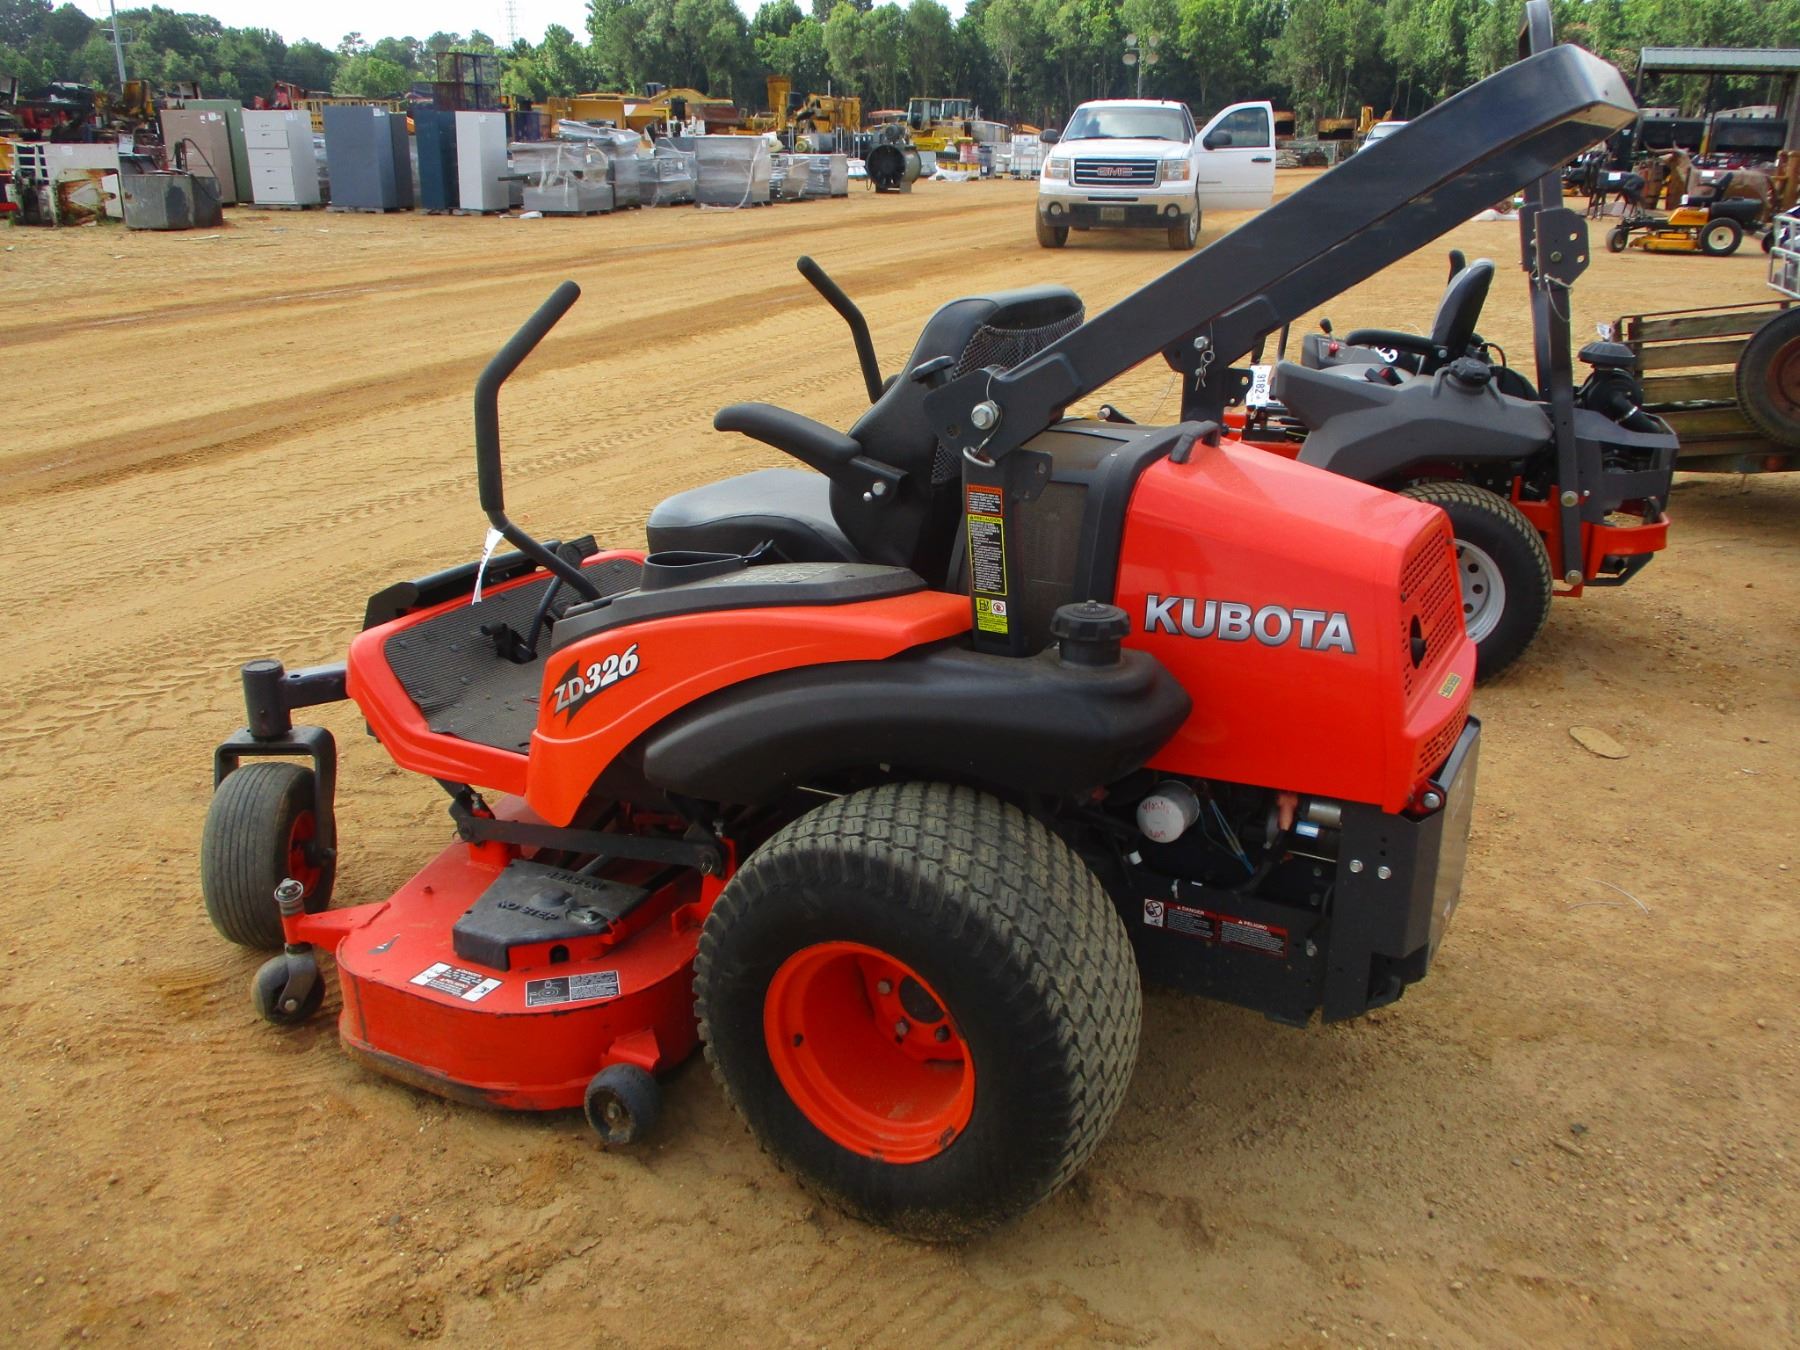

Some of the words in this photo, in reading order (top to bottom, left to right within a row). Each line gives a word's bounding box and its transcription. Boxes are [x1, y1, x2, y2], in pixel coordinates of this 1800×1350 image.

[1097, 166, 1132, 177] GMC
[1255, 374, 1266, 394] 9182
[1144, 594, 1356, 653] KUBOTA
[554, 643, 639, 713] ZD326
[520, 905, 561, 921] STEP
